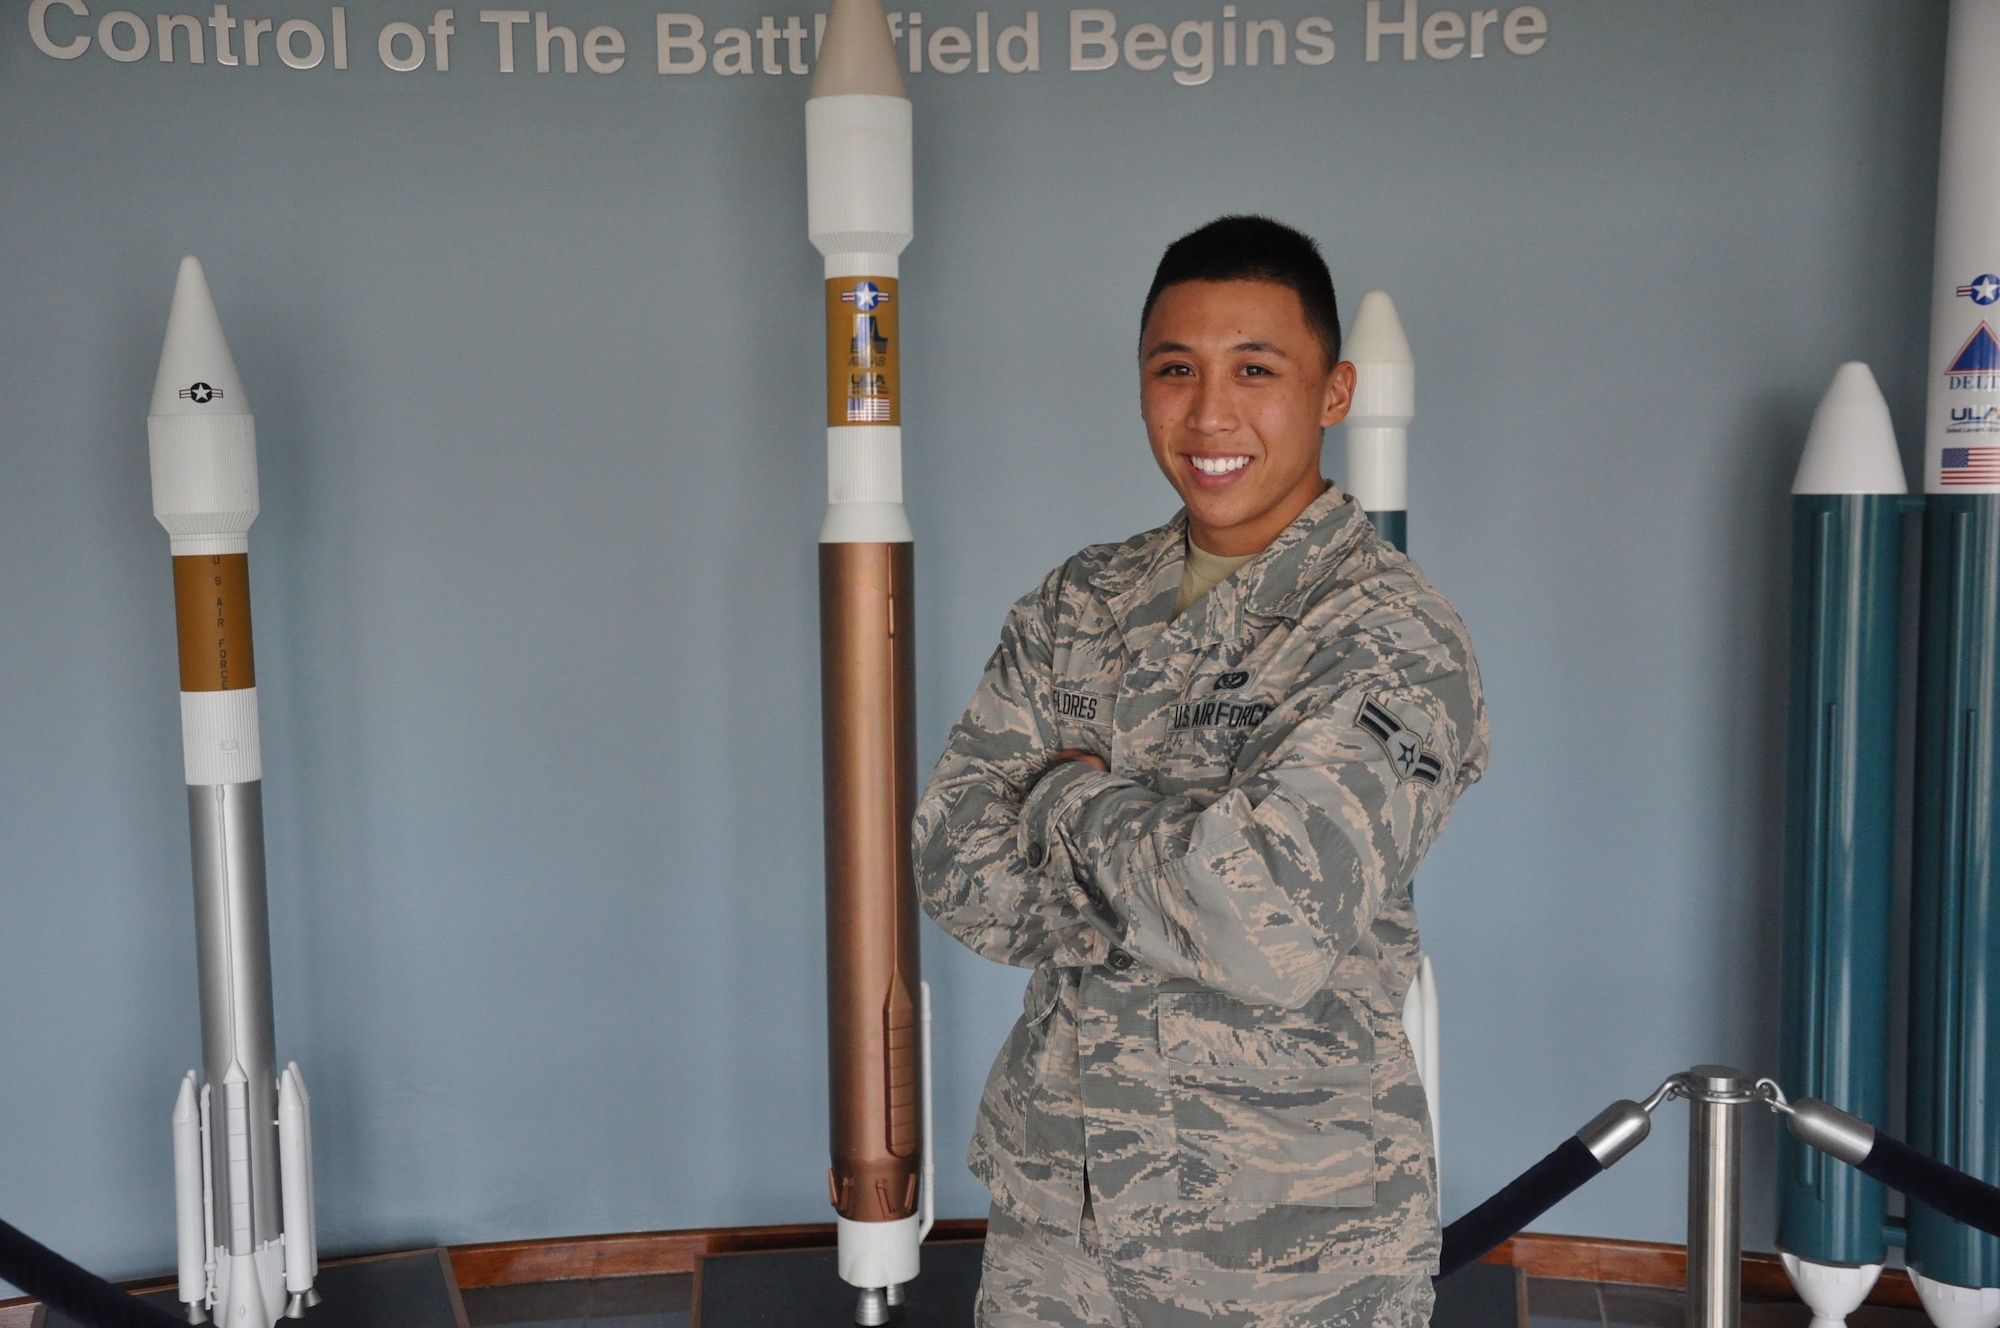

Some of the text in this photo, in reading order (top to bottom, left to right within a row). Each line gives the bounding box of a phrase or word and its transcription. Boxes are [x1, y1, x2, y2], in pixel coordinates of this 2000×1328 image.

[28, 0, 348, 70] Control
[378, 9, 455, 72] of
[480, 10, 626, 74] The
[1069, 4, 1335, 86] Begins
[1365, 0, 1548, 62] Here
[213, 555, 228, 689] U S AIR FORCE
[1192, 702, 1215, 727] AIR
